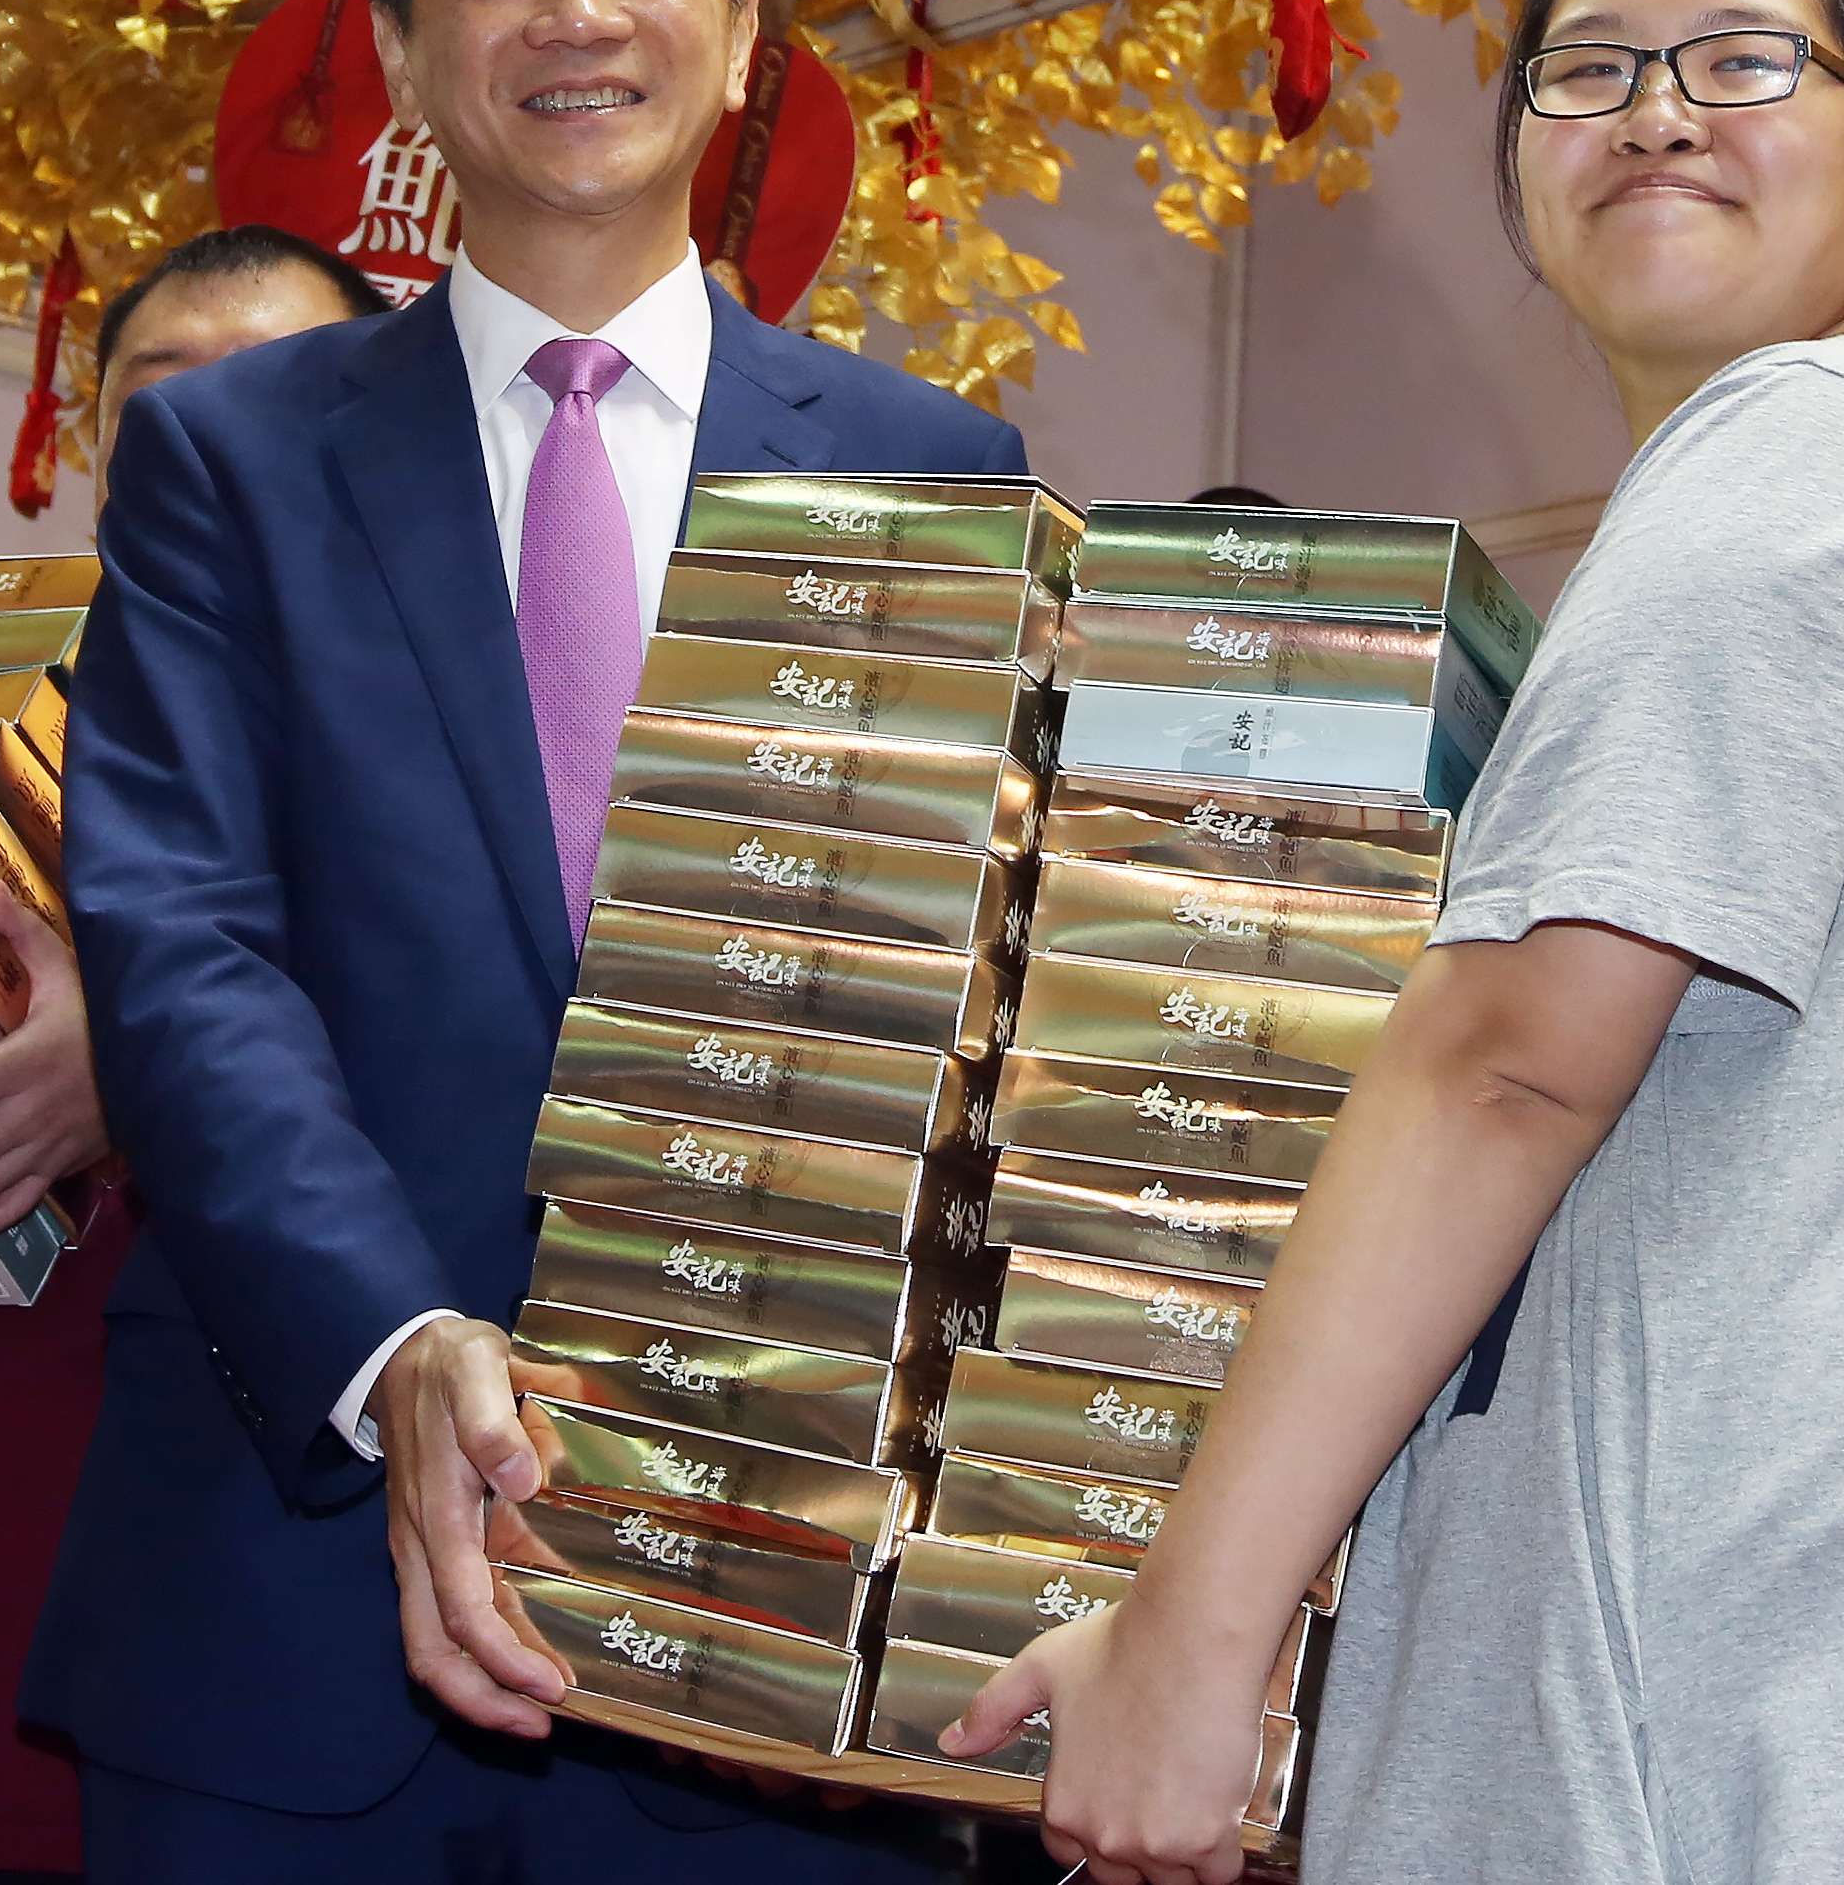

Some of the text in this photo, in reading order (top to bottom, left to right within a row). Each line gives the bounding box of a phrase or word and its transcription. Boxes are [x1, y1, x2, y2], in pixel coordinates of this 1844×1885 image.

[1207, 527, 1274, 571] 安記
[786, 569, 853, 615] 安記
[1186, 616, 1256, 660] 安記
[769, 660, 840, 709] 安記
[1228, 709, 1255, 752] 安記
[747, 740, 817, 786] 安記
[1184, 799, 1257, 844] 安記
[729, 836, 799, 889] 安記
[1172, 892, 1244, 936] 安記
[715, 933, 785, 985] 安記
[1159, 986, 1233, 1037] 安記
[687, 1032, 756, 1085] 安記
[1134, 1081, 1207, 1133] 安記
[661, 1131, 729, 1185] 安記
[1138, 1181, 1206, 1233] 安記
[661, 1238, 729, 1292] 安記
[1145, 1286, 1219, 1341] 安記
[638, 1338, 705, 1391] 安記
[1085, 1386, 1157, 1441] 安記
[641, 1441, 710, 1495] 安記
[614, 1512, 680, 1565] 安記
[1075, 1485, 1148, 1540] 安記
[600, 1611, 667, 1669] 安記
